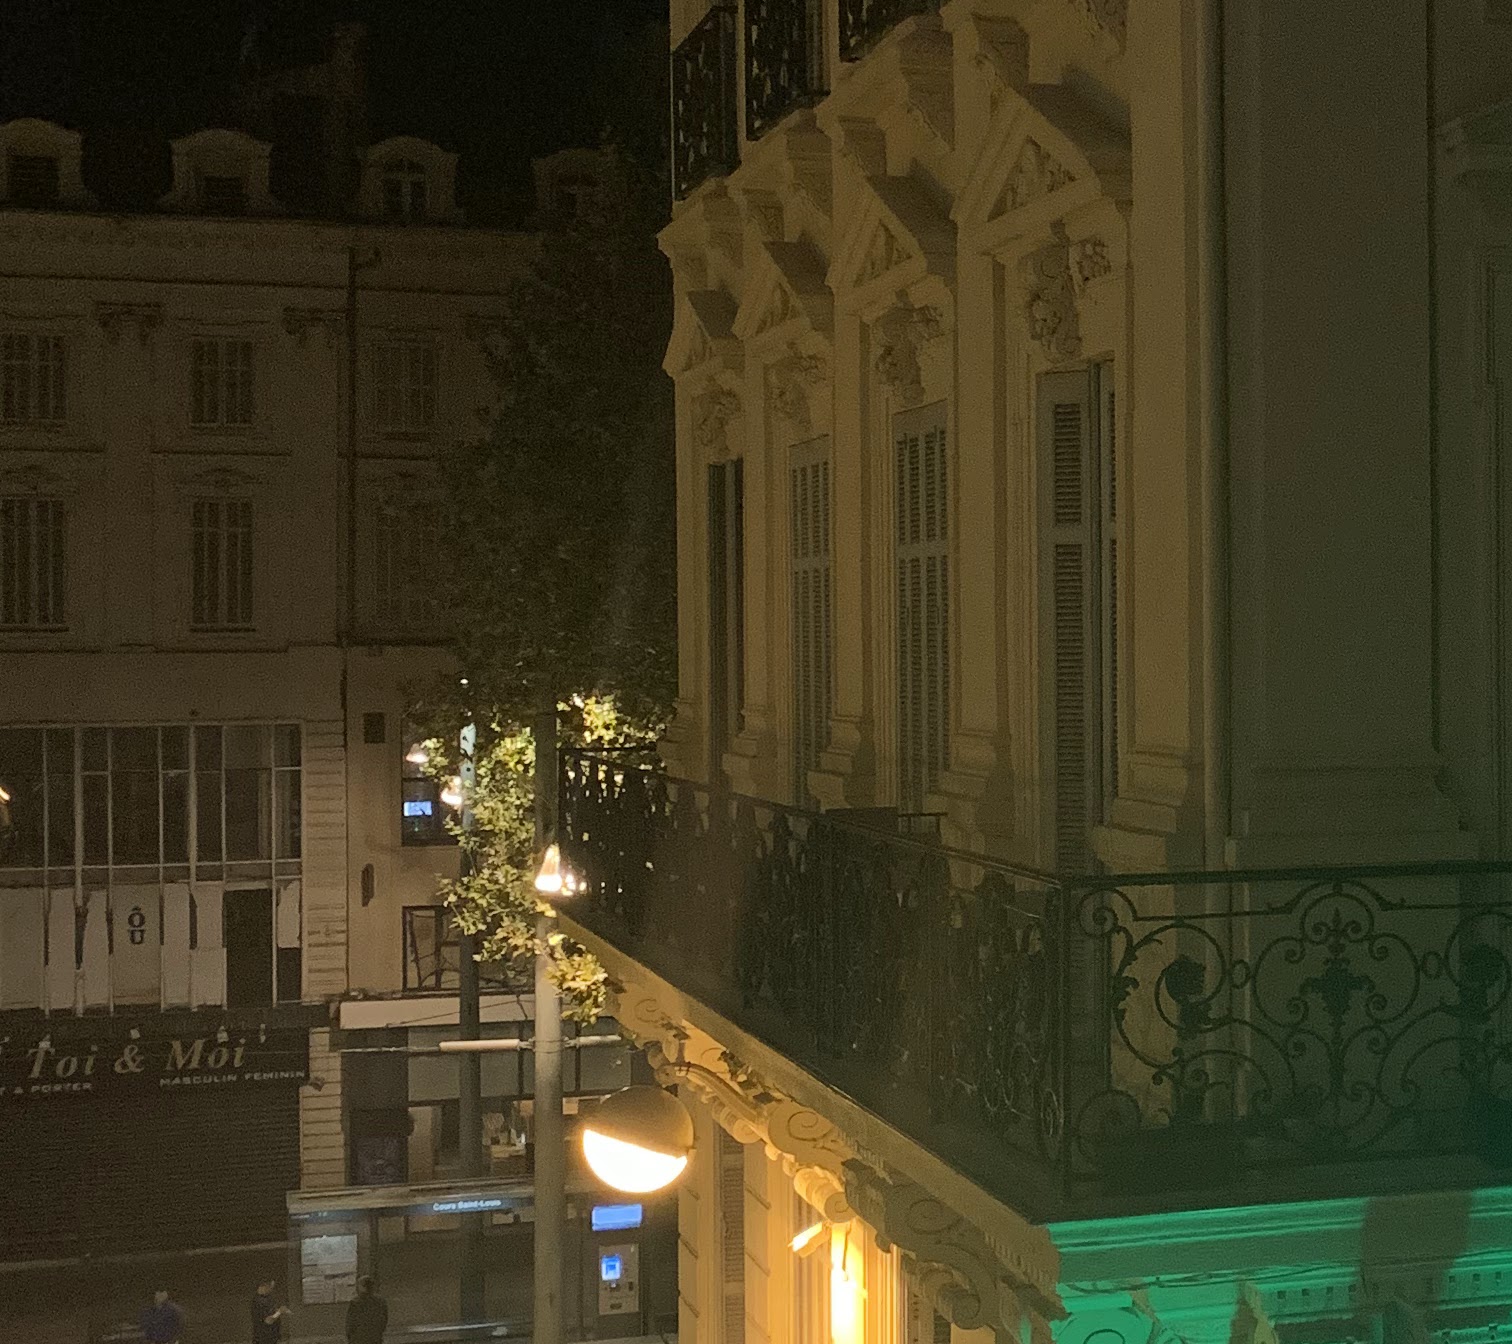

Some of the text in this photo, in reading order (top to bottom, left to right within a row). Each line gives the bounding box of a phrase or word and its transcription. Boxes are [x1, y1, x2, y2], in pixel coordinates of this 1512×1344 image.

[28, 1038, 246, 1078] Toi & Moi
[160, 1074, 237, 1087] MASCULIN
